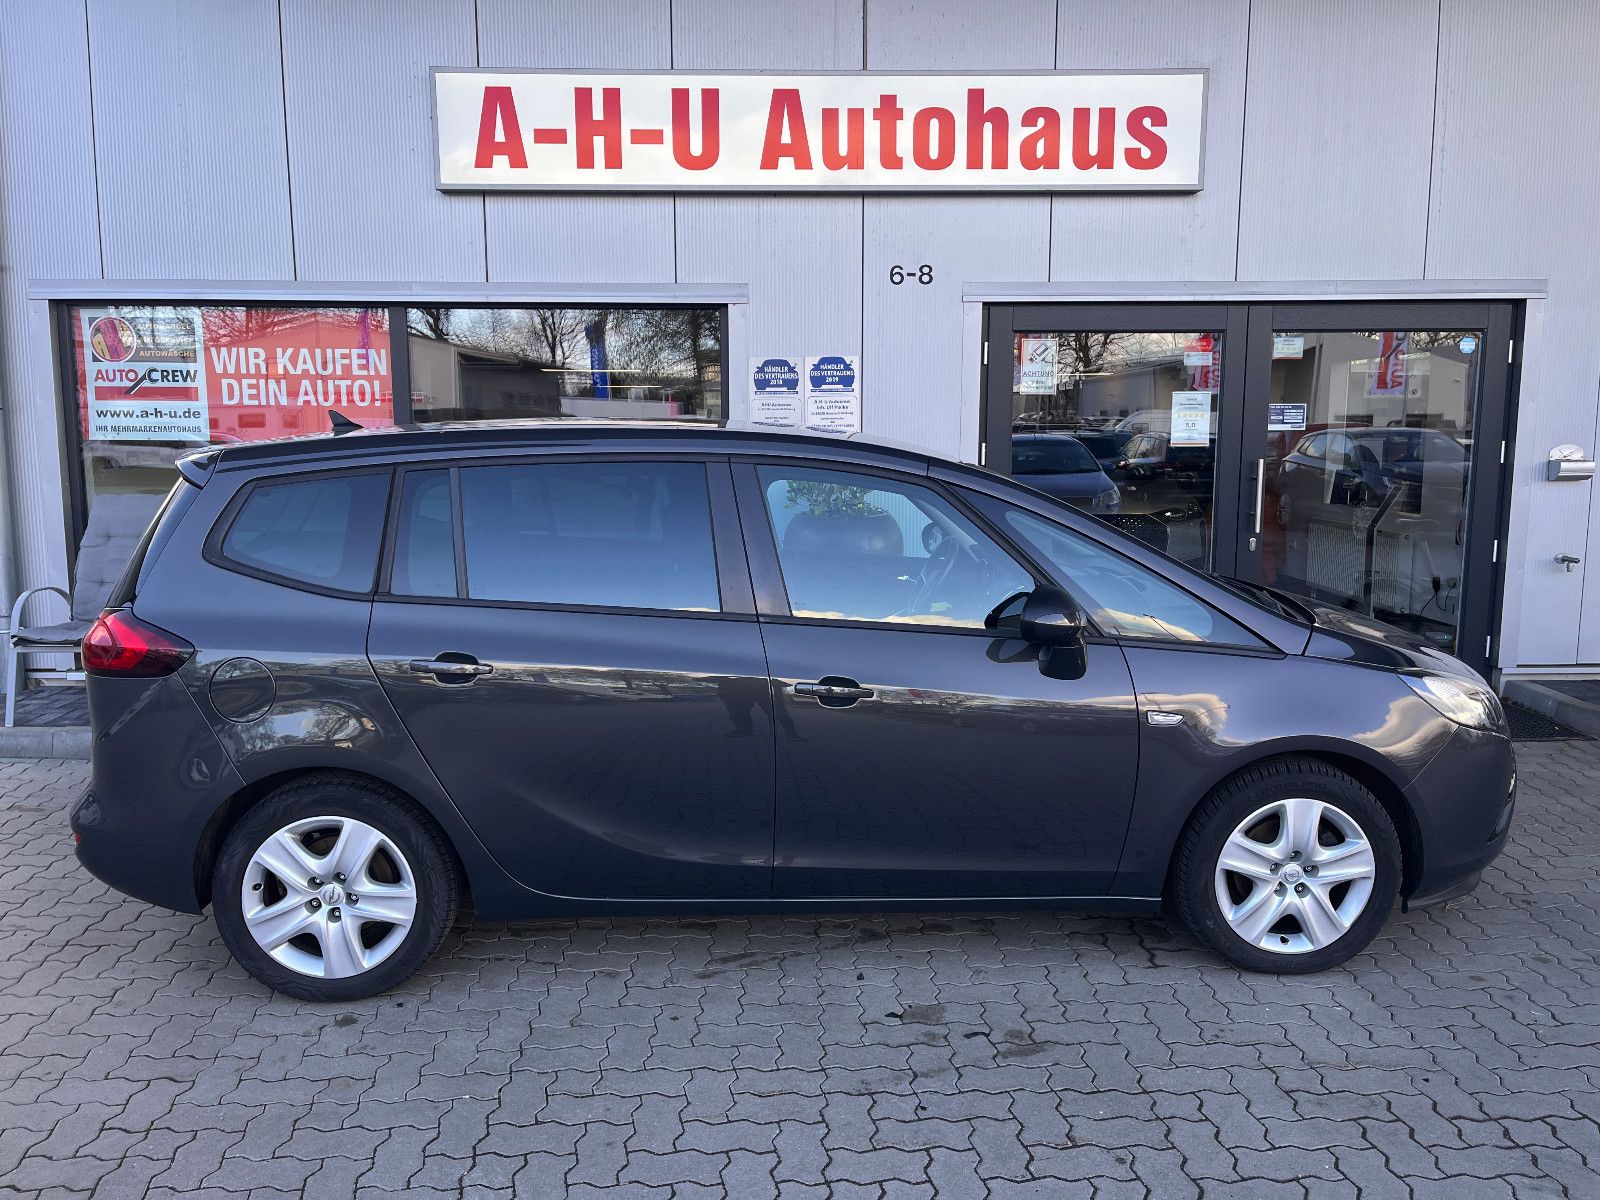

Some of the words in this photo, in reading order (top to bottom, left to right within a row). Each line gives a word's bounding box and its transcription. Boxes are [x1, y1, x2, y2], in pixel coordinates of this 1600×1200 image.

[474, 86, 719, 170] A-H-U
[760, 88, 1167, 170] Autohaus
[889, 264, 934, 285] 6-8
[210, 347, 267, 375] WIR
[277, 347, 388, 376] KAUFEN
[764, 365, 789, 373] HÄNDLER
[221, 379, 288, 406] DEIN
[296, 379, 381, 407] AUTO!
[96, 408, 202, 419] www.a-h-u.de
[110, 425, 202, 433] MEHRMARKENAUTOHAUS
